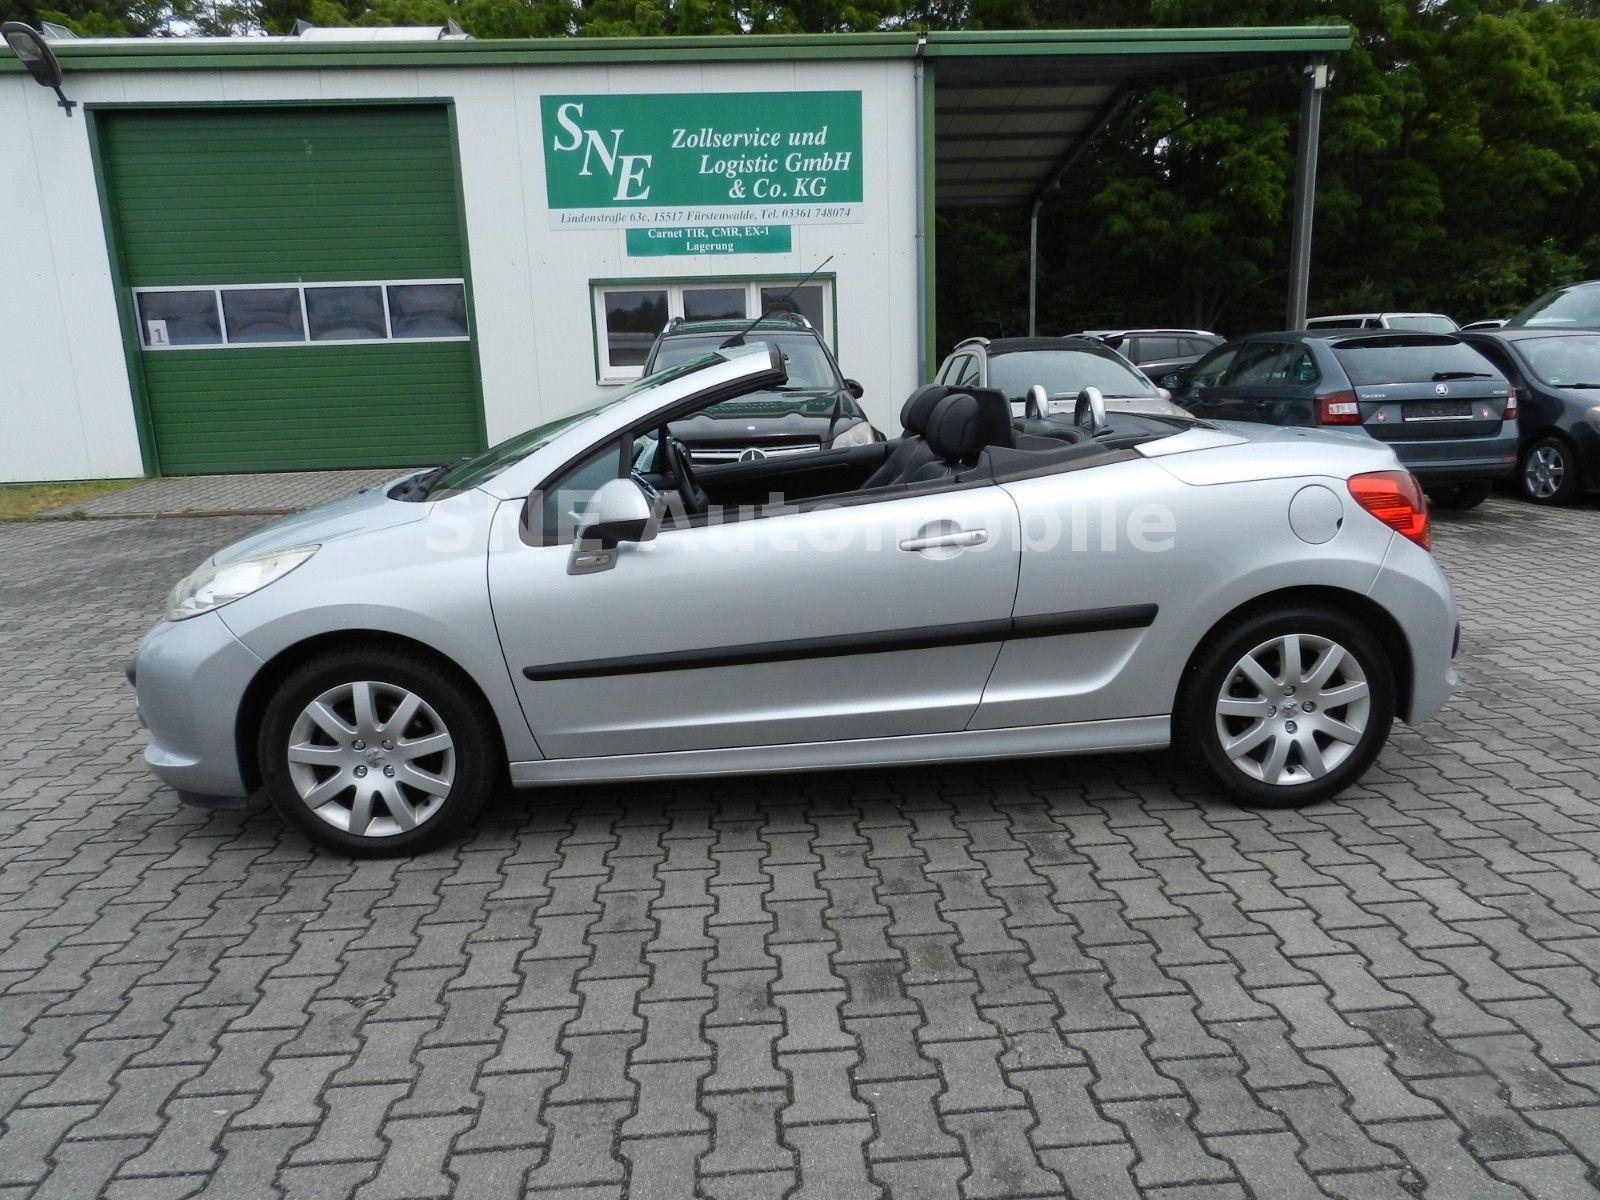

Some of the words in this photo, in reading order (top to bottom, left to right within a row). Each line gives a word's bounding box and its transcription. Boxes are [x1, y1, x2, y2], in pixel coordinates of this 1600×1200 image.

[671, 127, 781, 149] Zollservice
[788, 126, 828, 147] und
[553, 102, 653, 201] SNE
[699, 154, 779, 179] Logistic
[785, 151, 852, 173] GmbH
[728, 179, 747, 199] &
[753, 178, 788, 198] Co.
[794, 177, 828, 197] KG
[560, 211, 627, 225] Lindenstraße
[654, 210, 684, 222] 15517
[686, 209, 758, 221] Fürstenwalde,
[761, 208, 779, 219] Tel.
[781, 207, 812, 218] 03361
[815, 206, 851, 218] 748074
[647, 228, 683, 239] Carnet
[684, 228, 709, 239] TIR,
[711, 227, 743, 238] CMR,
[686, 241, 734, 253] Lagerung
